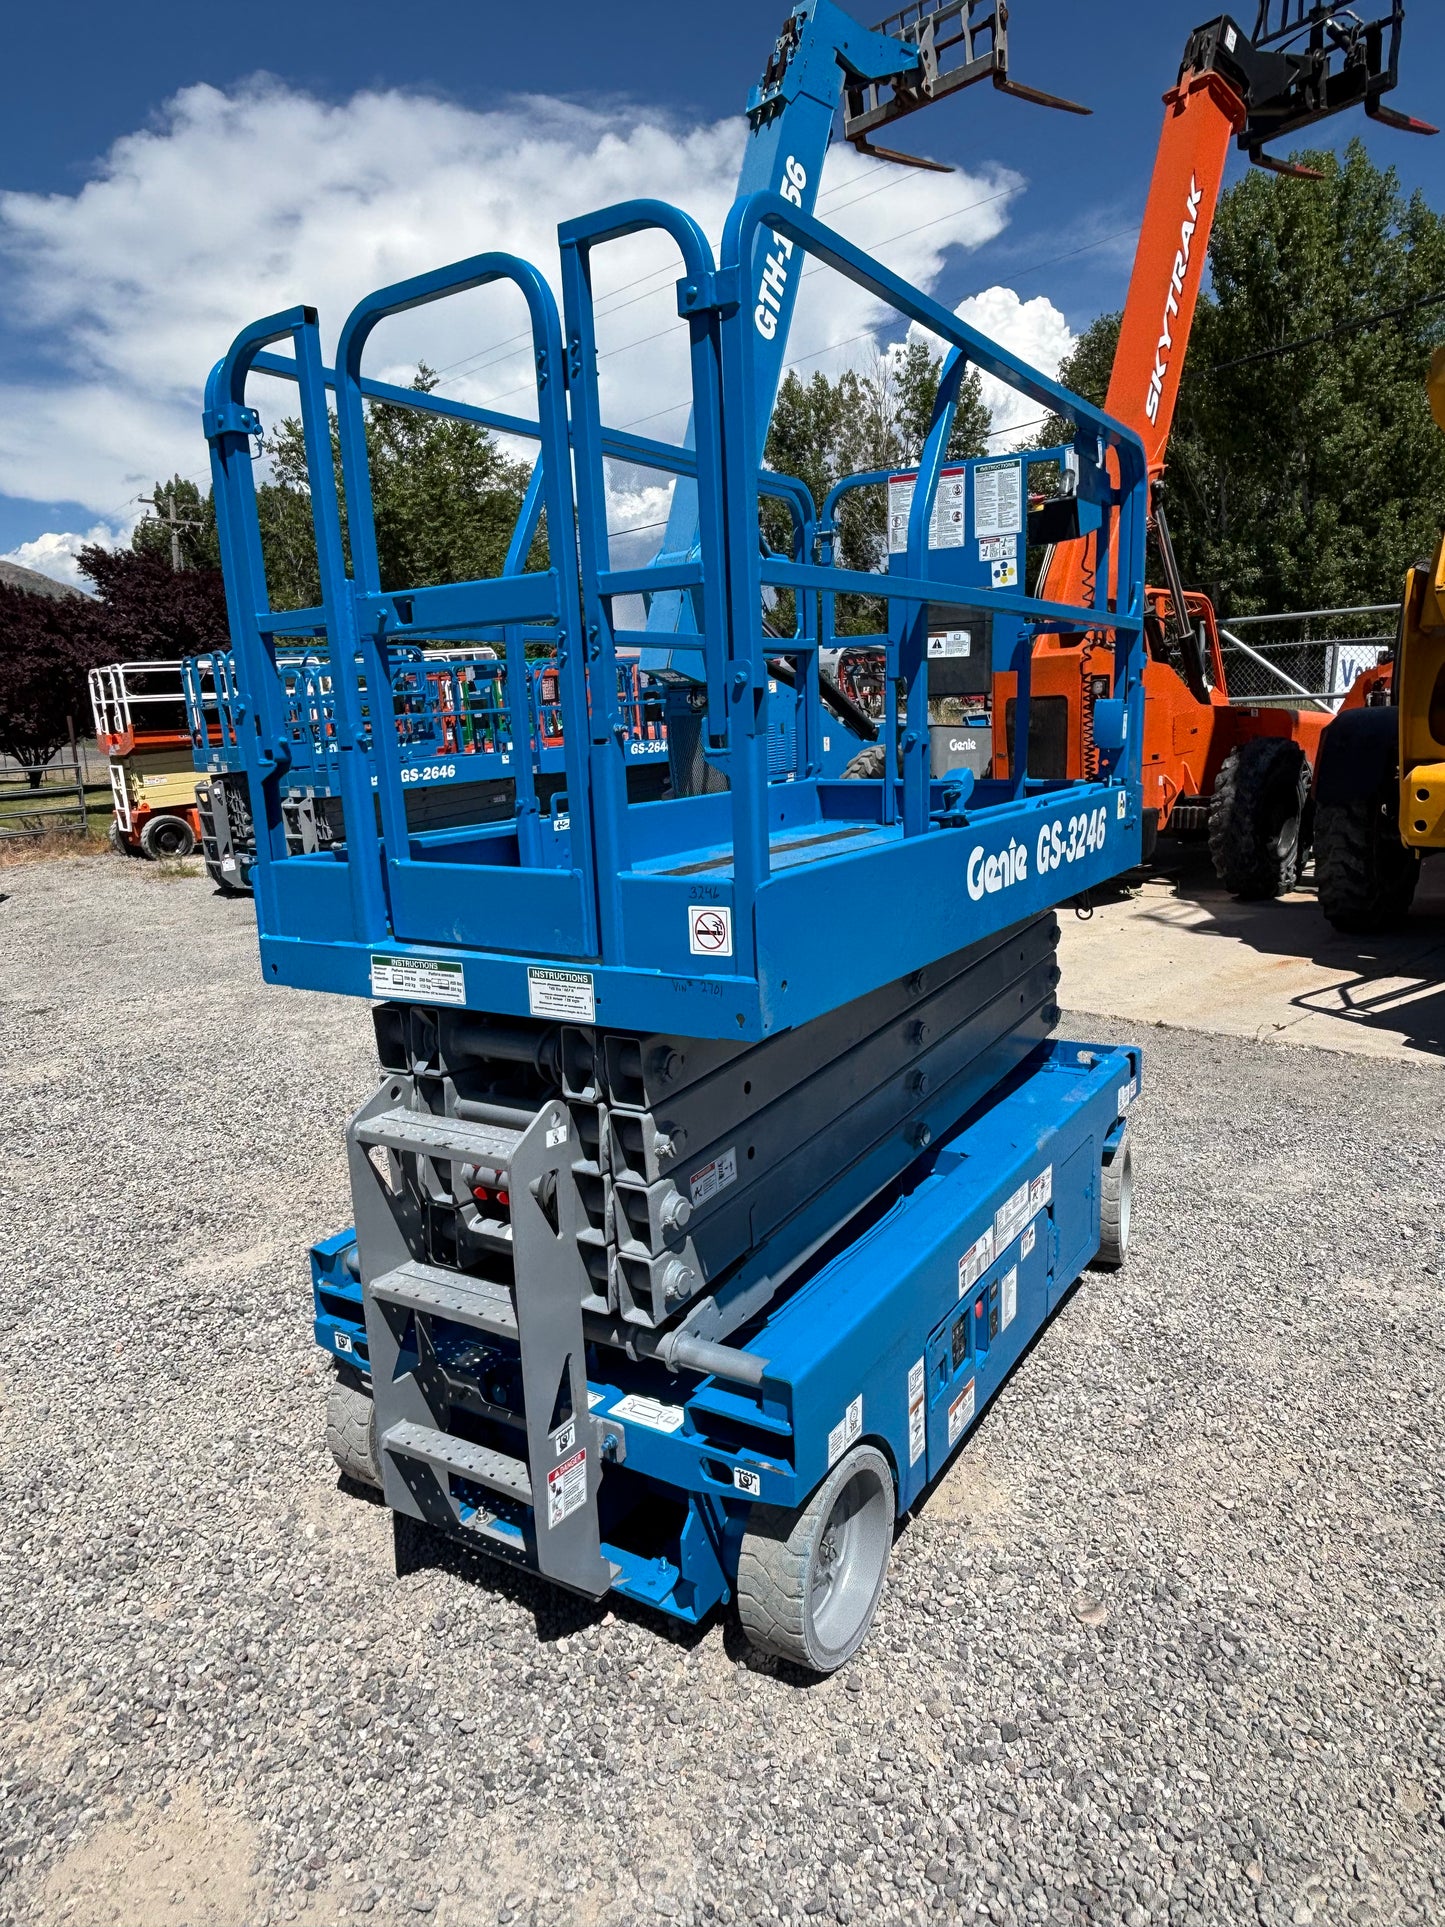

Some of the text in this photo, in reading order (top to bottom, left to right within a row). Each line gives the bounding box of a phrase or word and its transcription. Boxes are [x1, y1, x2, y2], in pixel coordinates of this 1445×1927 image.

[754, 155, 806, 341] GTH-156
[1146, 169, 1203, 427] SKYTRAK
[949, 738, 977, 751] Genie
[401, 764, 456, 783] GS-2646
[967, 806, 1107, 901] Genie GS-3246
[689, 885, 720, 900] 3246
[391, 959, 439, 970] INSTRUCTIONS
[532, 969, 588, 983] INSTRUCTIONS
